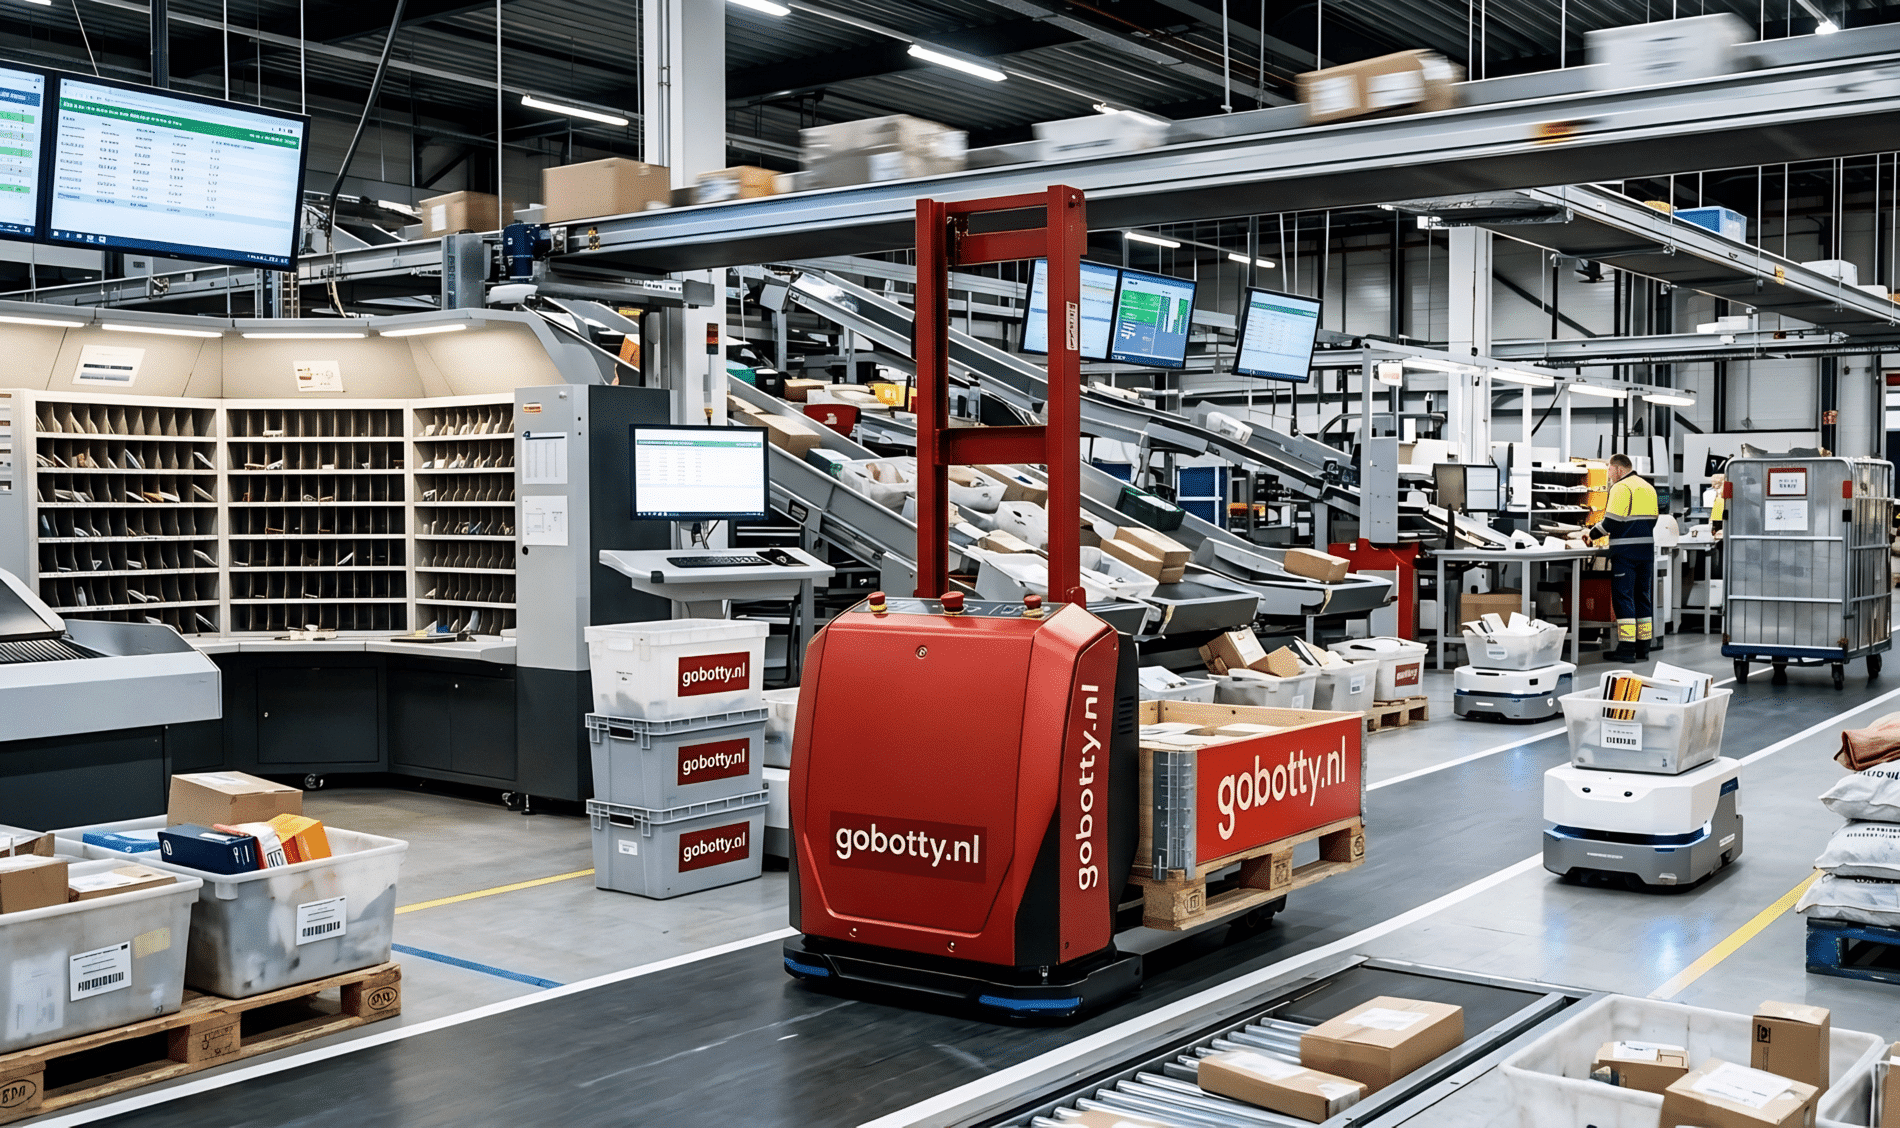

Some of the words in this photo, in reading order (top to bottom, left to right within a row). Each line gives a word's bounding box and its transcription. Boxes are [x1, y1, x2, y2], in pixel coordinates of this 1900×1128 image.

[682, 662, 746, 687] gobotty.nl
[683, 748, 746, 776] gobotty.nl
[1076, 684, 1102, 891] gobotty.nl
[1217, 735, 1346, 840] gobotty.nl
[835, 824, 979, 868] gobotty.nl
